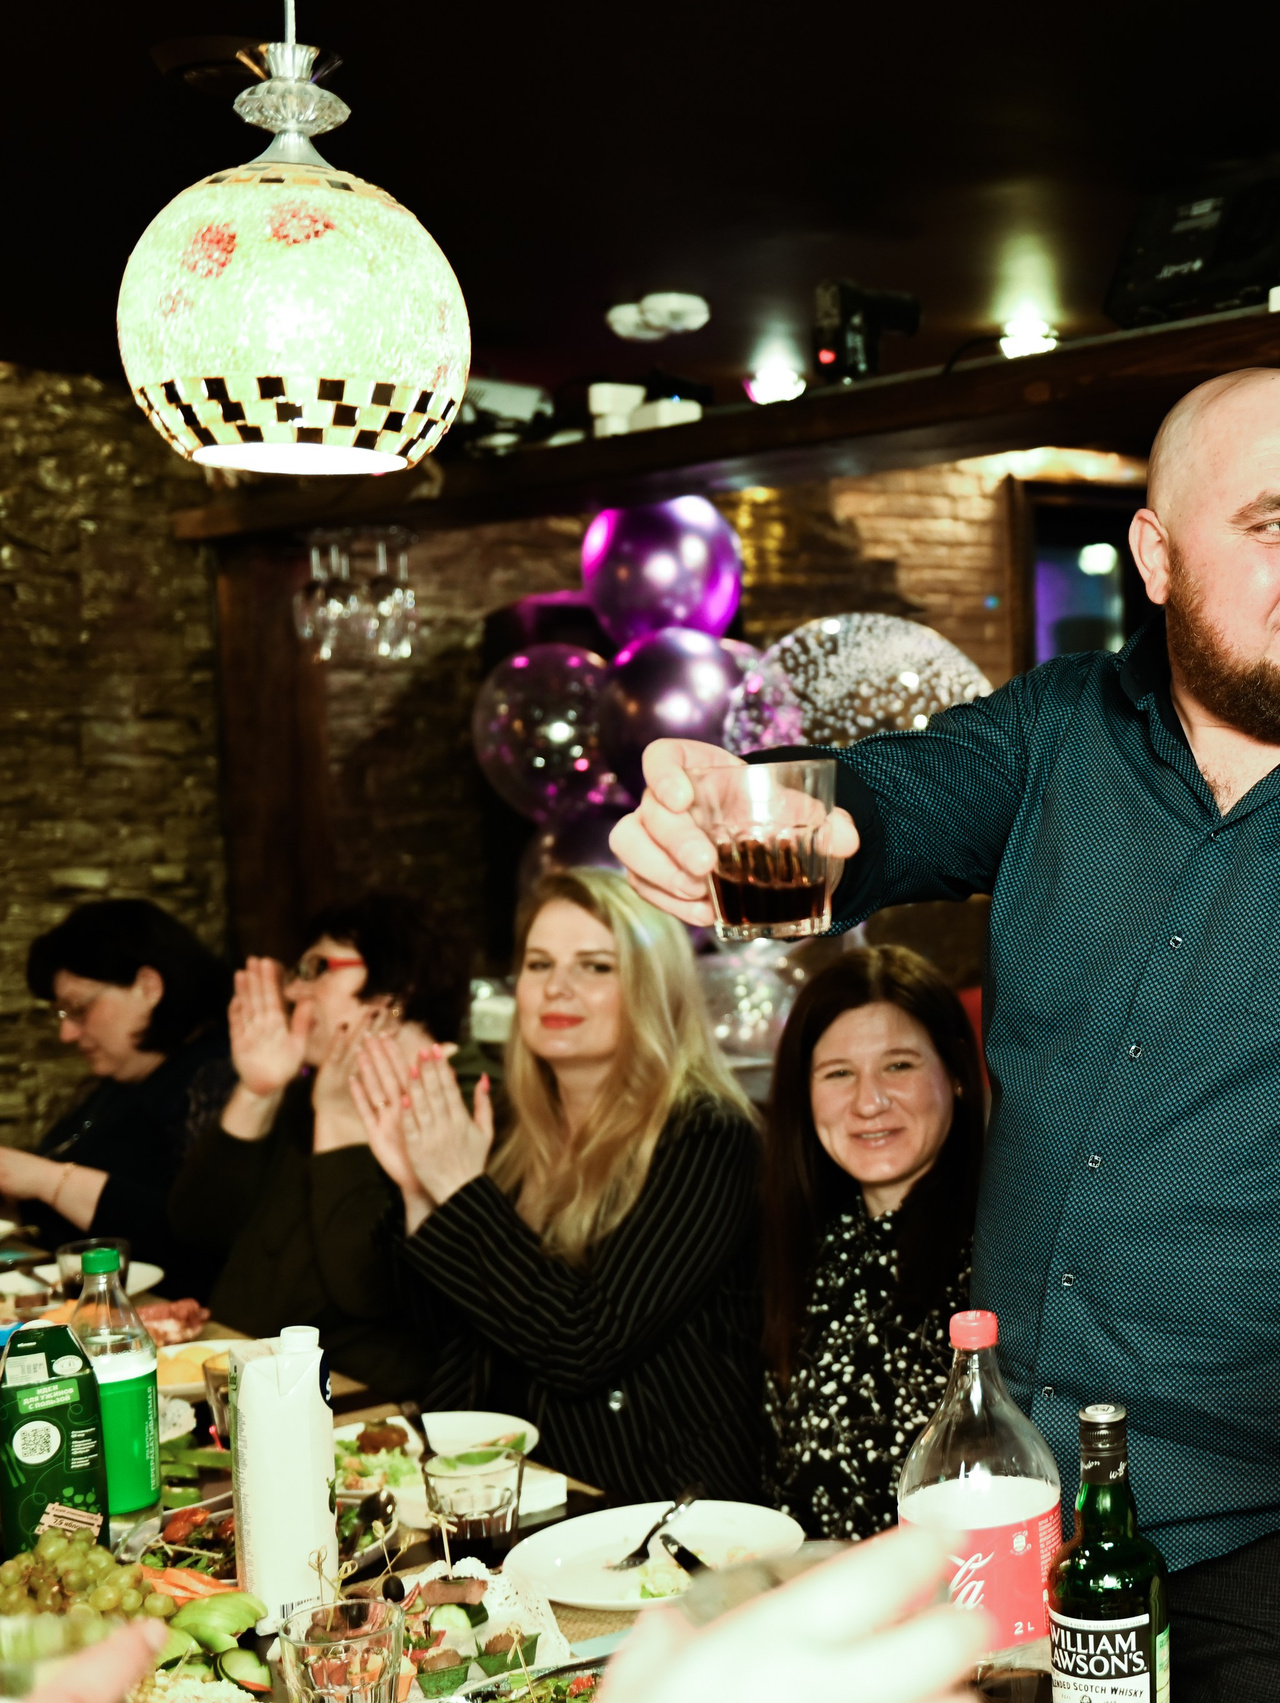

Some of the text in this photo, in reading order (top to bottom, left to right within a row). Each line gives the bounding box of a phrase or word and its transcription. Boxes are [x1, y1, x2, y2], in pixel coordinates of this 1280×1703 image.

[23, 1387, 74, 1405] ДЛЯ УЖИНОВ
[34, 1394, 71, 1408] ПОЛЬЗОЙ
[1013, 1621, 1035, 1636] 2 L
[1050, 1621, 1137, 1654] WILLIAM
[1073, 1682, 1107, 1694] SCOTCH
[1110, 1687, 1144, 1698] WHISKY
